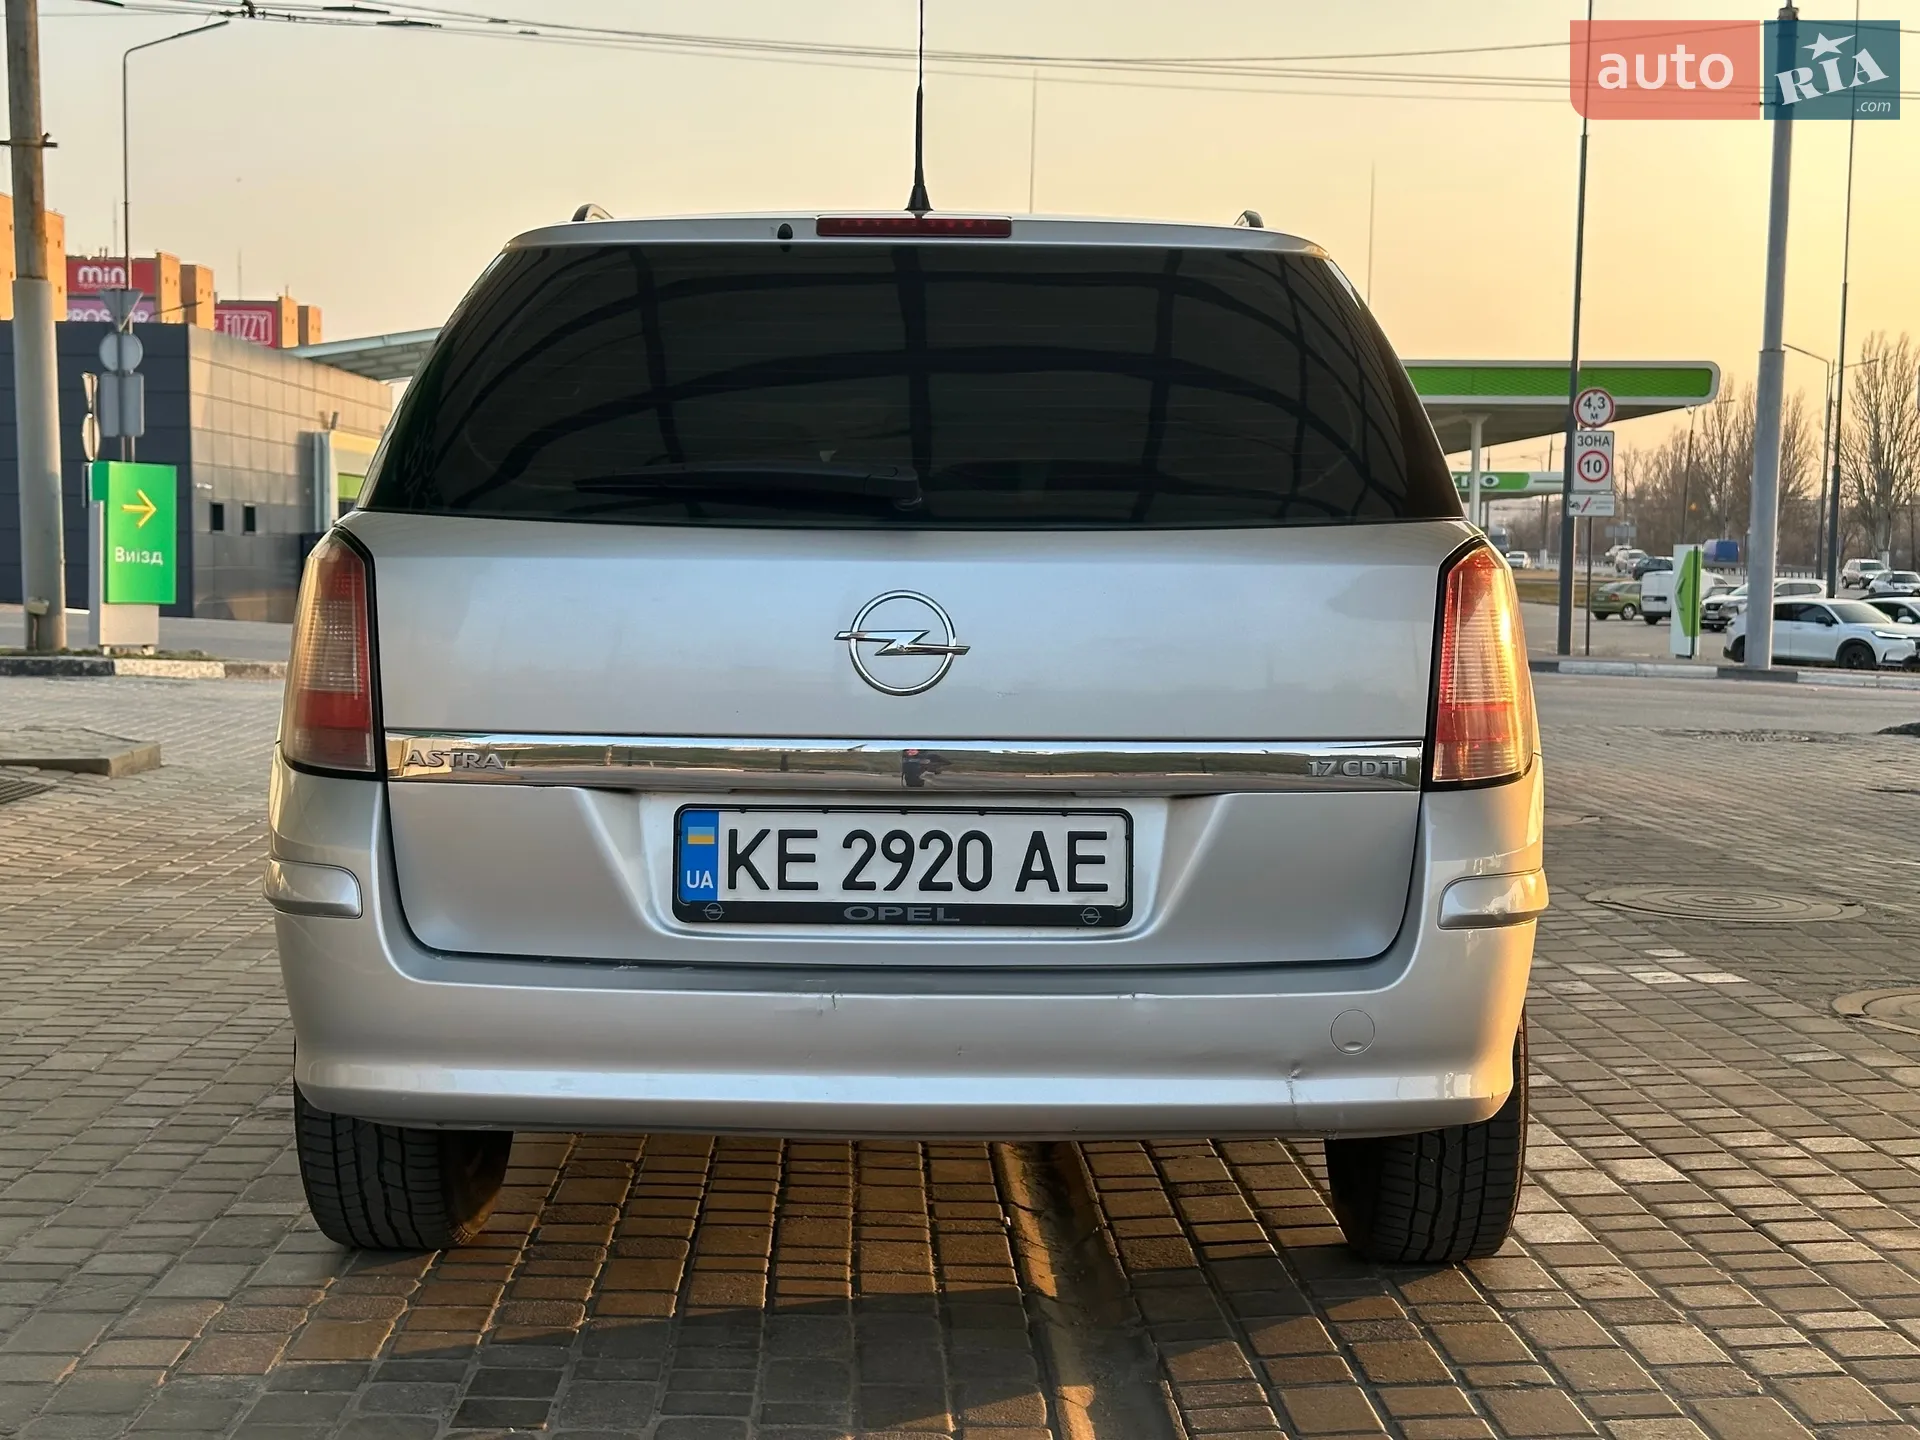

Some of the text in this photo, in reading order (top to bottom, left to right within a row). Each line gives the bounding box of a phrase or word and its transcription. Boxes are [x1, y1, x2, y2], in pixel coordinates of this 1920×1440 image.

[1583, 397, 1606, 411] 4,3
[1577, 435, 1610, 447] ЗОНА
[1584, 460, 1602, 474] 10
[404, 750, 505, 769] ASTRA
[727, 828, 1109, 892] KE 2920 AE
[686, 870, 714, 889] UA
[843, 906, 960, 922] OPEL
